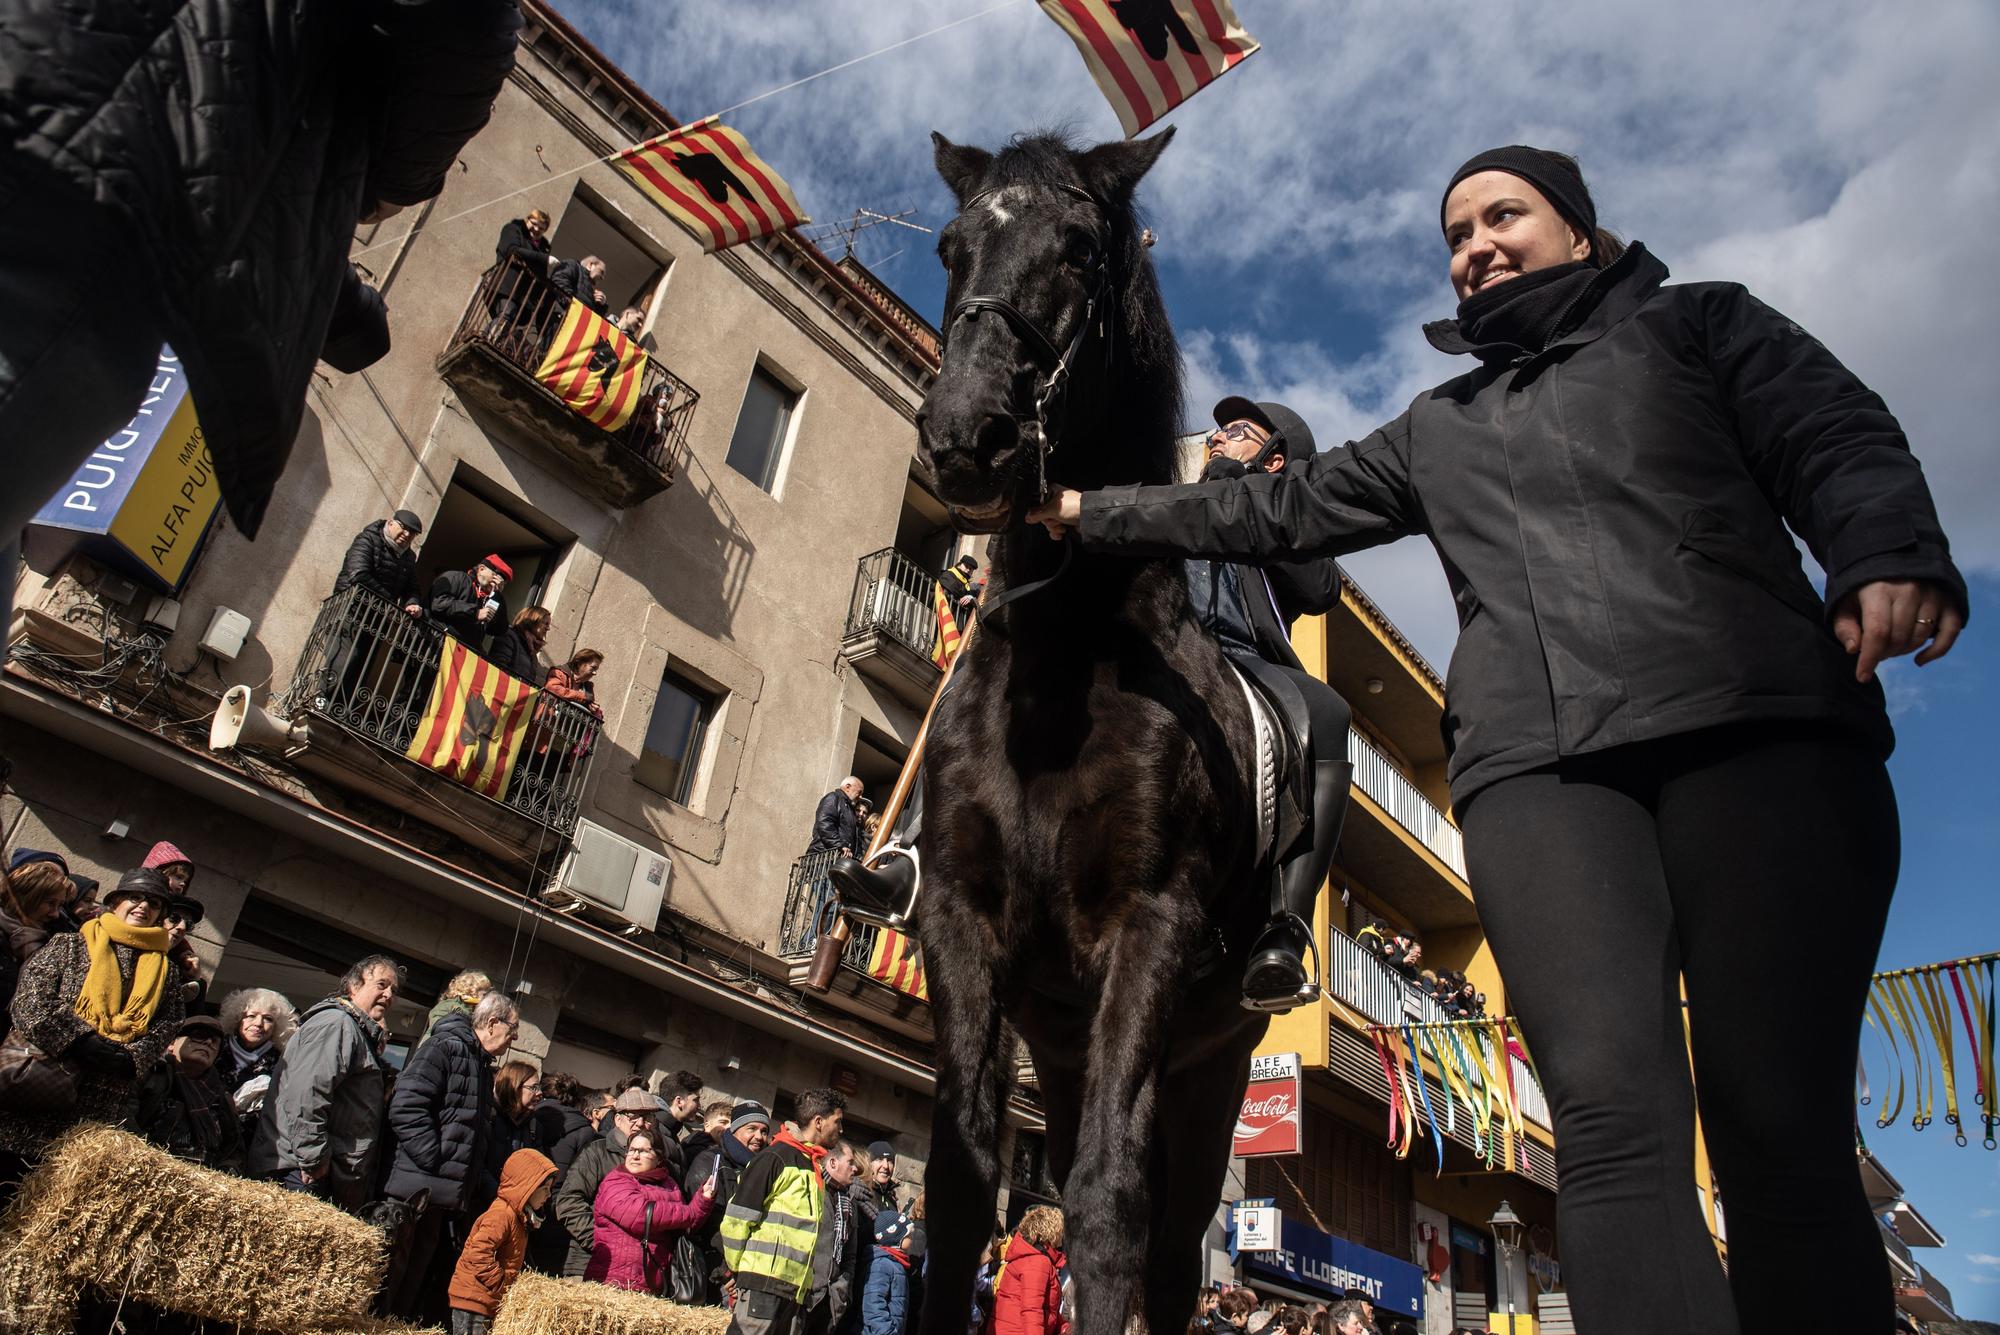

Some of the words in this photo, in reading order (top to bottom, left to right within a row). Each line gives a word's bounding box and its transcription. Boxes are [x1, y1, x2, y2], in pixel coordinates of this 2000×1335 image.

[151, 504, 190, 566] ALFA
[1302, 1255, 1383, 1300] LLOBREGAT
[1411, 1298, 1418, 1311] 3
